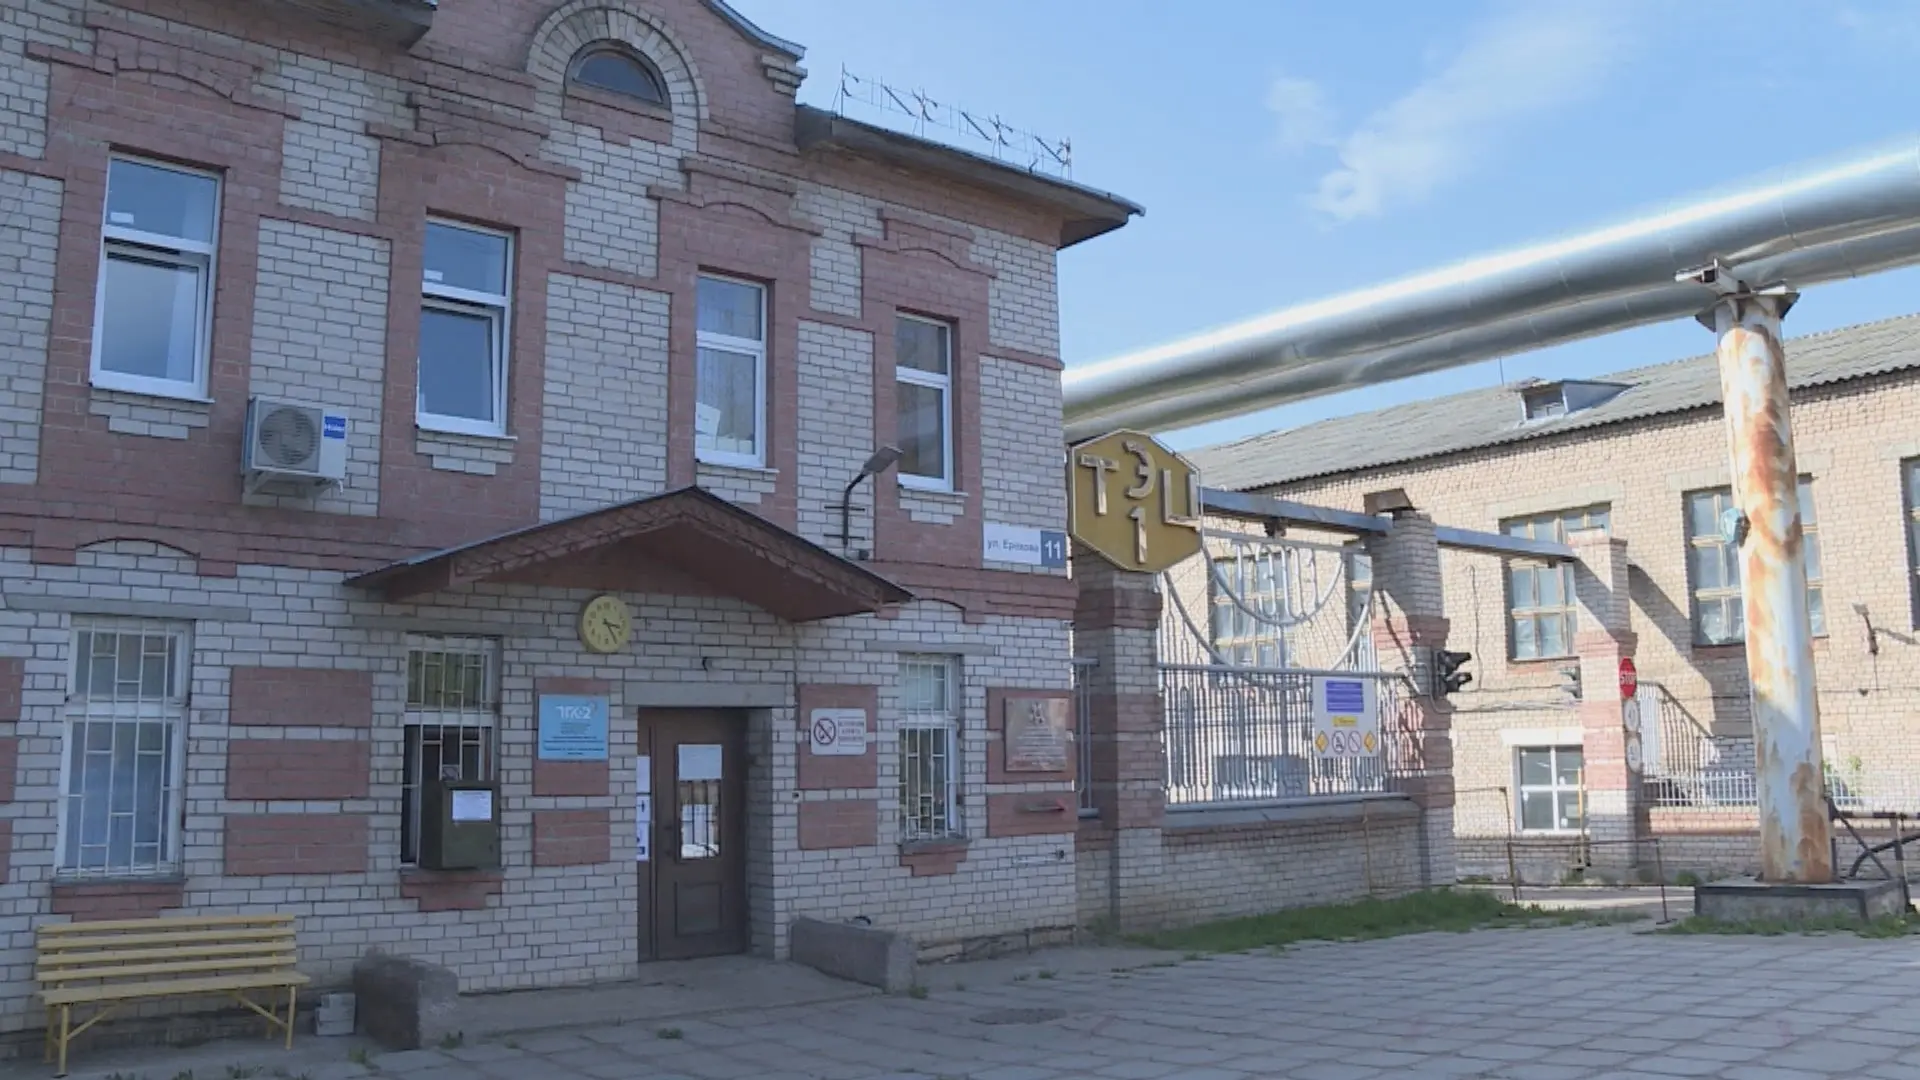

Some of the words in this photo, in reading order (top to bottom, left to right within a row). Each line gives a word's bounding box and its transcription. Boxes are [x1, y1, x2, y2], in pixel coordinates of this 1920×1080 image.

[1080, 440, 1203, 535] ТЭЦ
[1044, 540, 1061, 560] 11
[1128, 506, 1149, 565] 1
